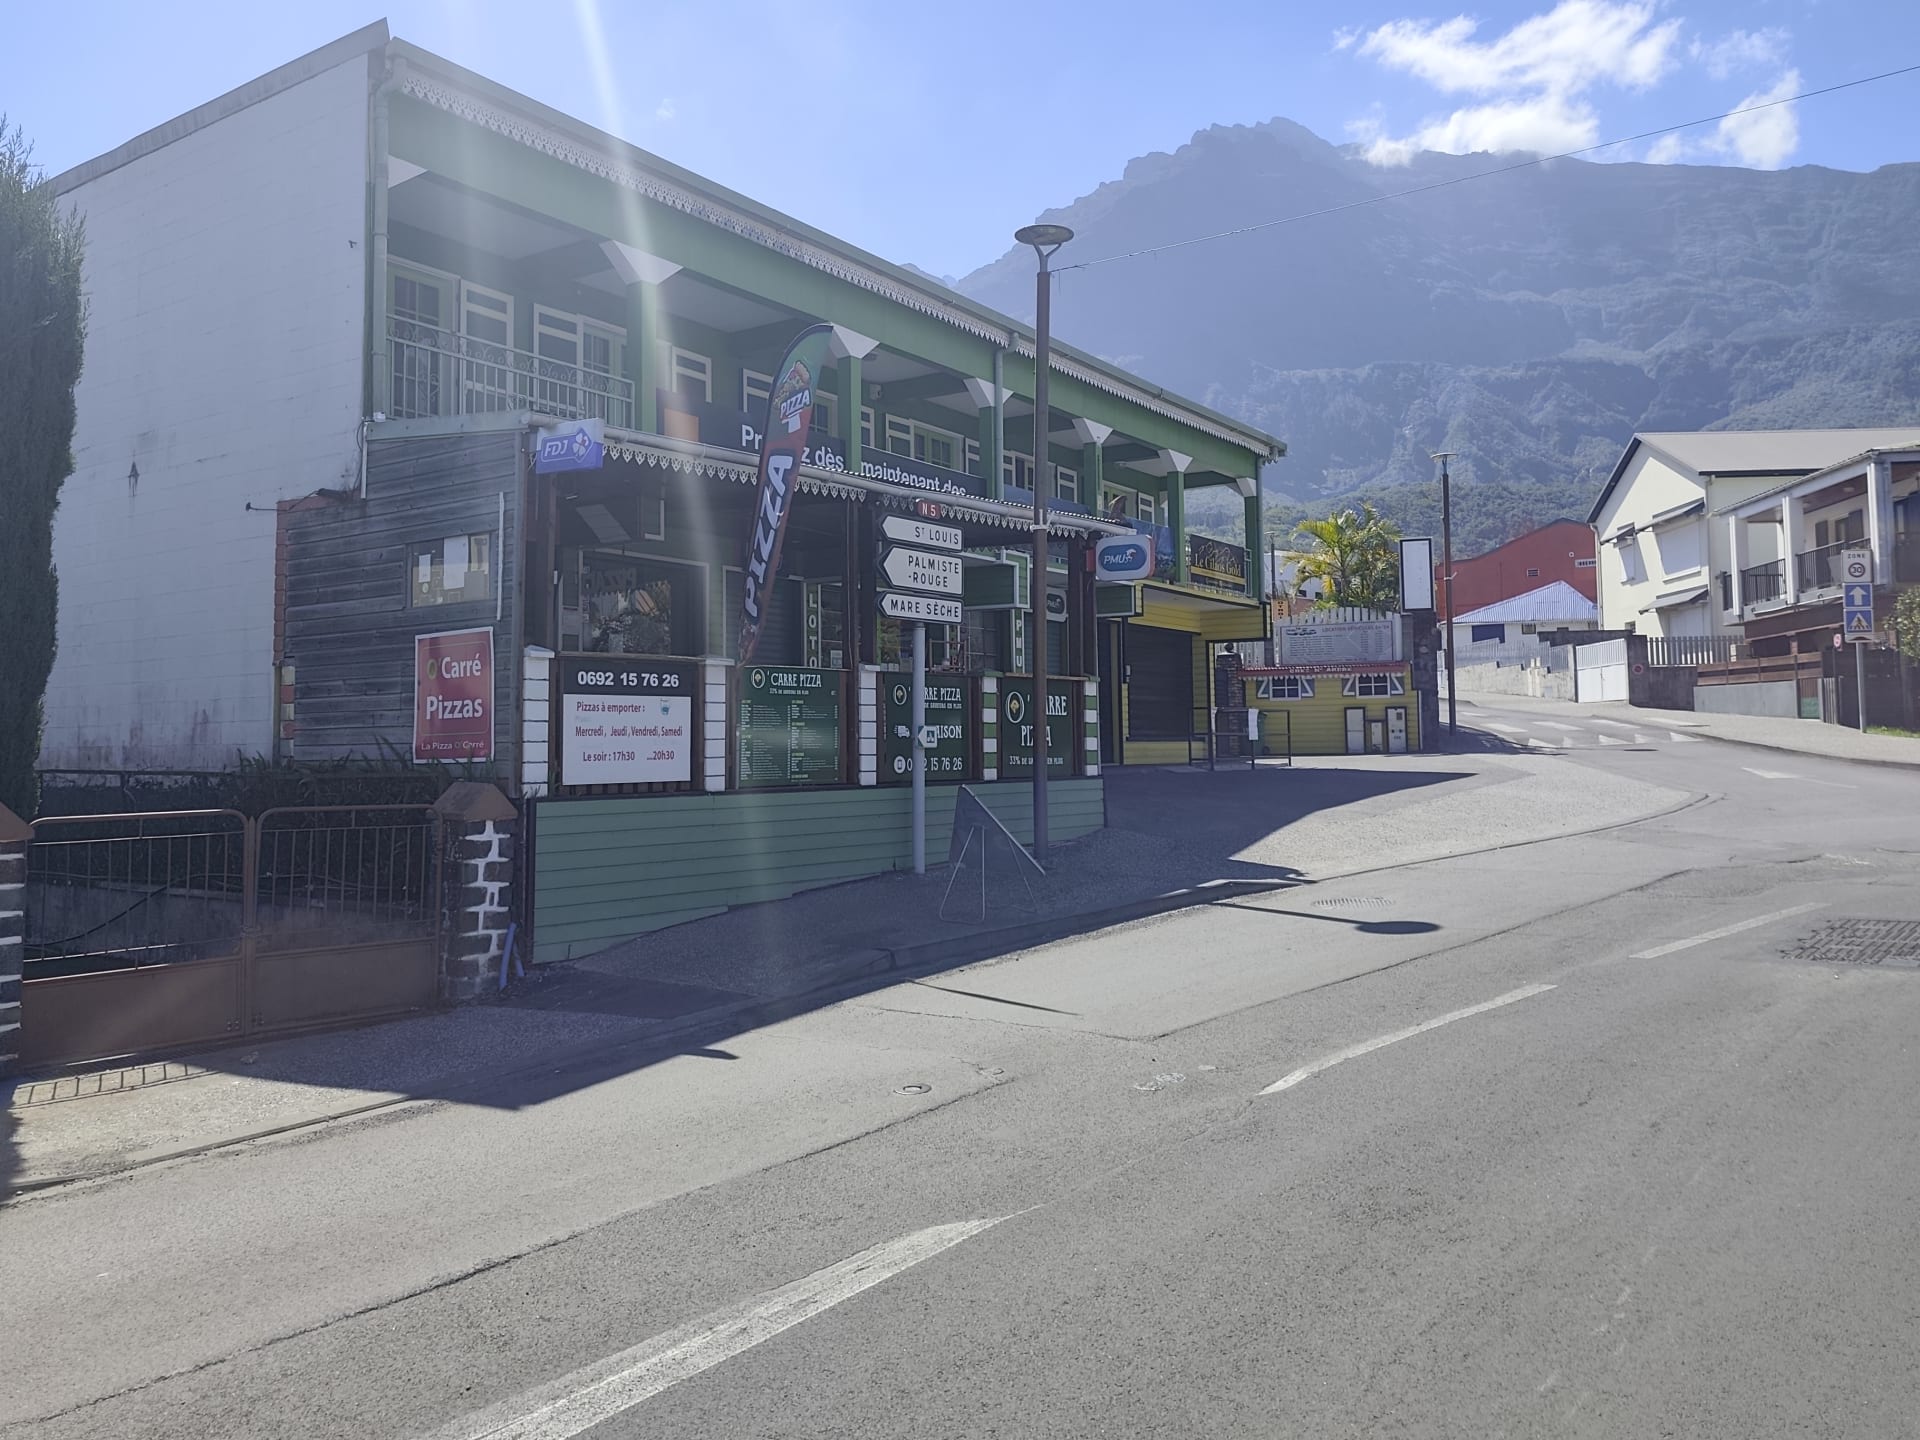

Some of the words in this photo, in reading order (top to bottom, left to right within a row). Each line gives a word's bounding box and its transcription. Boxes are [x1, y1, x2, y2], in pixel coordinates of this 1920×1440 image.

[780, 389, 811, 419] PIZZA
[544, 439, 569, 457] FDJ
[815, 446, 844, 471] dès
[861, 461, 940, 491] maintenant
[922, 503, 928, 515] N
[744, 455, 794, 617] PIZZA
[929, 530, 959, 545] LOUIS
[908, 555, 959, 574] PALMISTE
[1104, 554, 1125, 565] PMU
[1852, 566, 1862, 574] 30
[890, 599, 920, 613] MARE
[926, 601, 959, 618] SÈCHE
[1015, 619, 1023, 667] PMU
[441, 653, 482, 679] Carré
[577, 671, 614, 686] 0692
[620, 672, 638, 687] 15
[641, 673, 659, 687] 76
[662, 674, 680, 688] 26
[771, 673, 798, 687] CARRE
[800, 674, 822, 688] PIZZA
[940, 687, 962, 702] PIZZA
[426, 694, 483, 720] Pizzas
[576, 701, 600, 712] Pizzas
[601, 702, 606, 712] à
[607, 703, 641, 715] emporter
[661, 726, 683, 737] Samedi
[1021, 725, 1052, 747] PIA
[421, 743, 431, 751] La
[432, 740, 453, 751] Pizza
[583, 752, 592, 762] Le
[593, 751, 608, 762] soir
[613, 751, 636, 761] 17h30
[930, 757, 939, 771] 15
[941, 757, 951, 771] 76
[953, 757, 963, 771] 26
